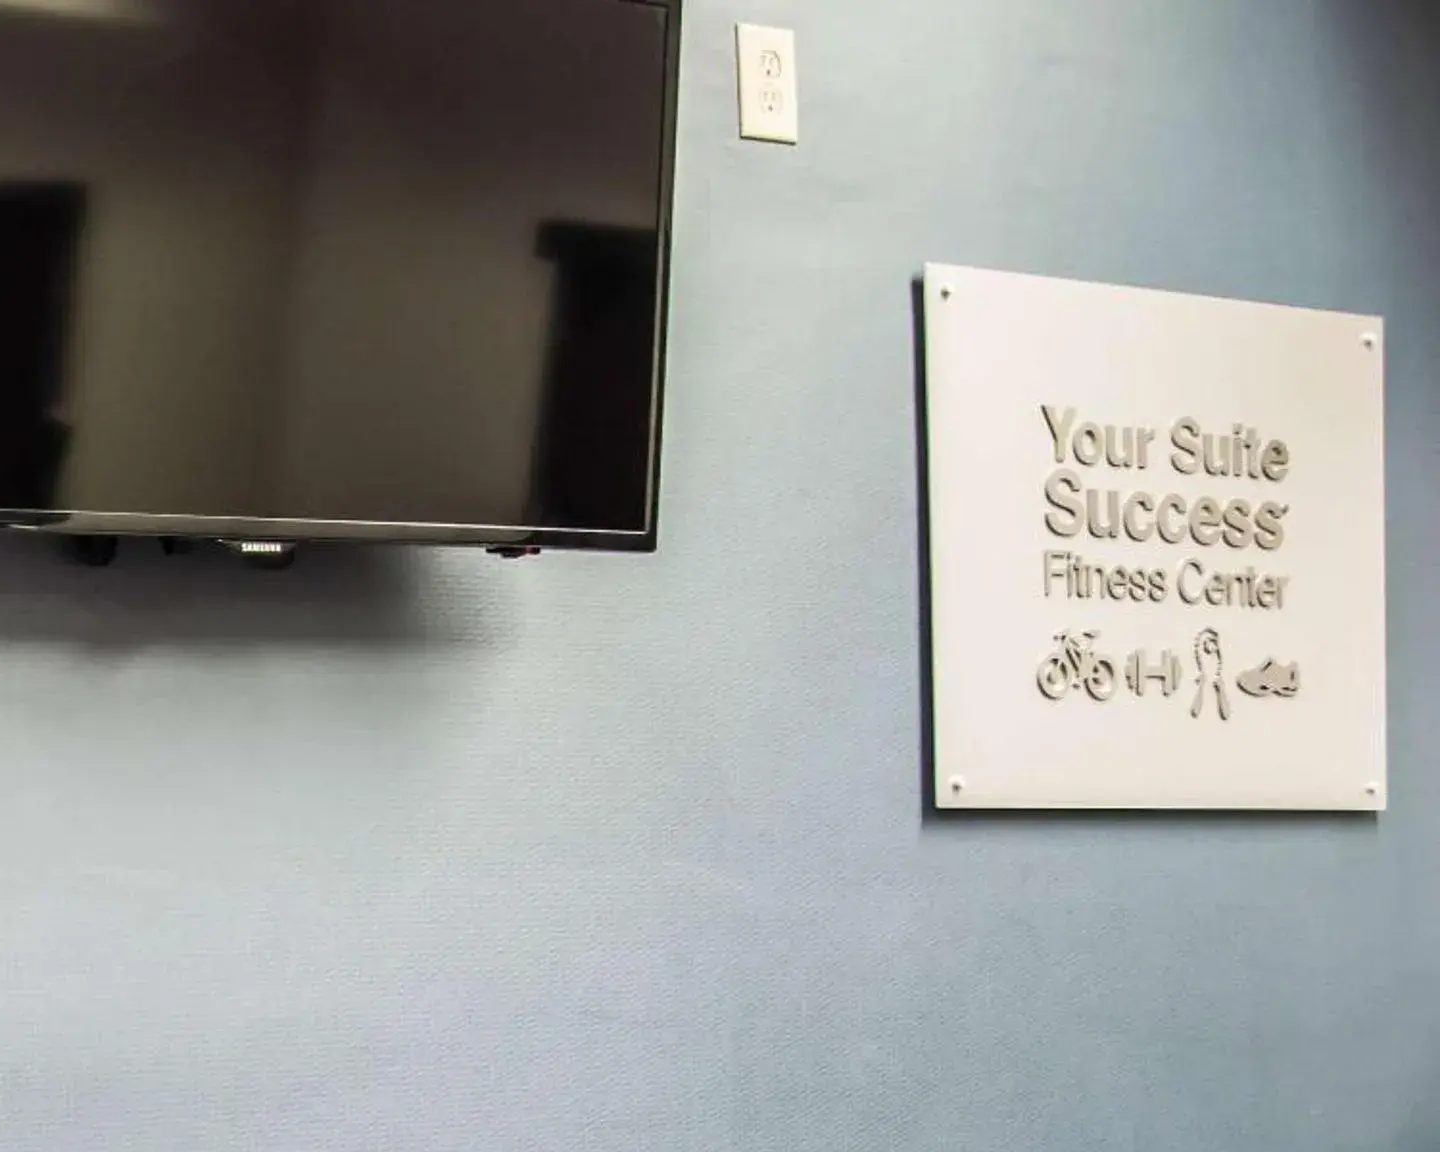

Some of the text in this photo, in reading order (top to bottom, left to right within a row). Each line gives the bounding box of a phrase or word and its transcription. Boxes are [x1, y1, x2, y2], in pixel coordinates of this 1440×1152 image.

[1041, 404, 1290, 483] Your Suite
[1044, 467, 1289, 551] Success
[1043, 550, 1290, 609] Fitness Center
